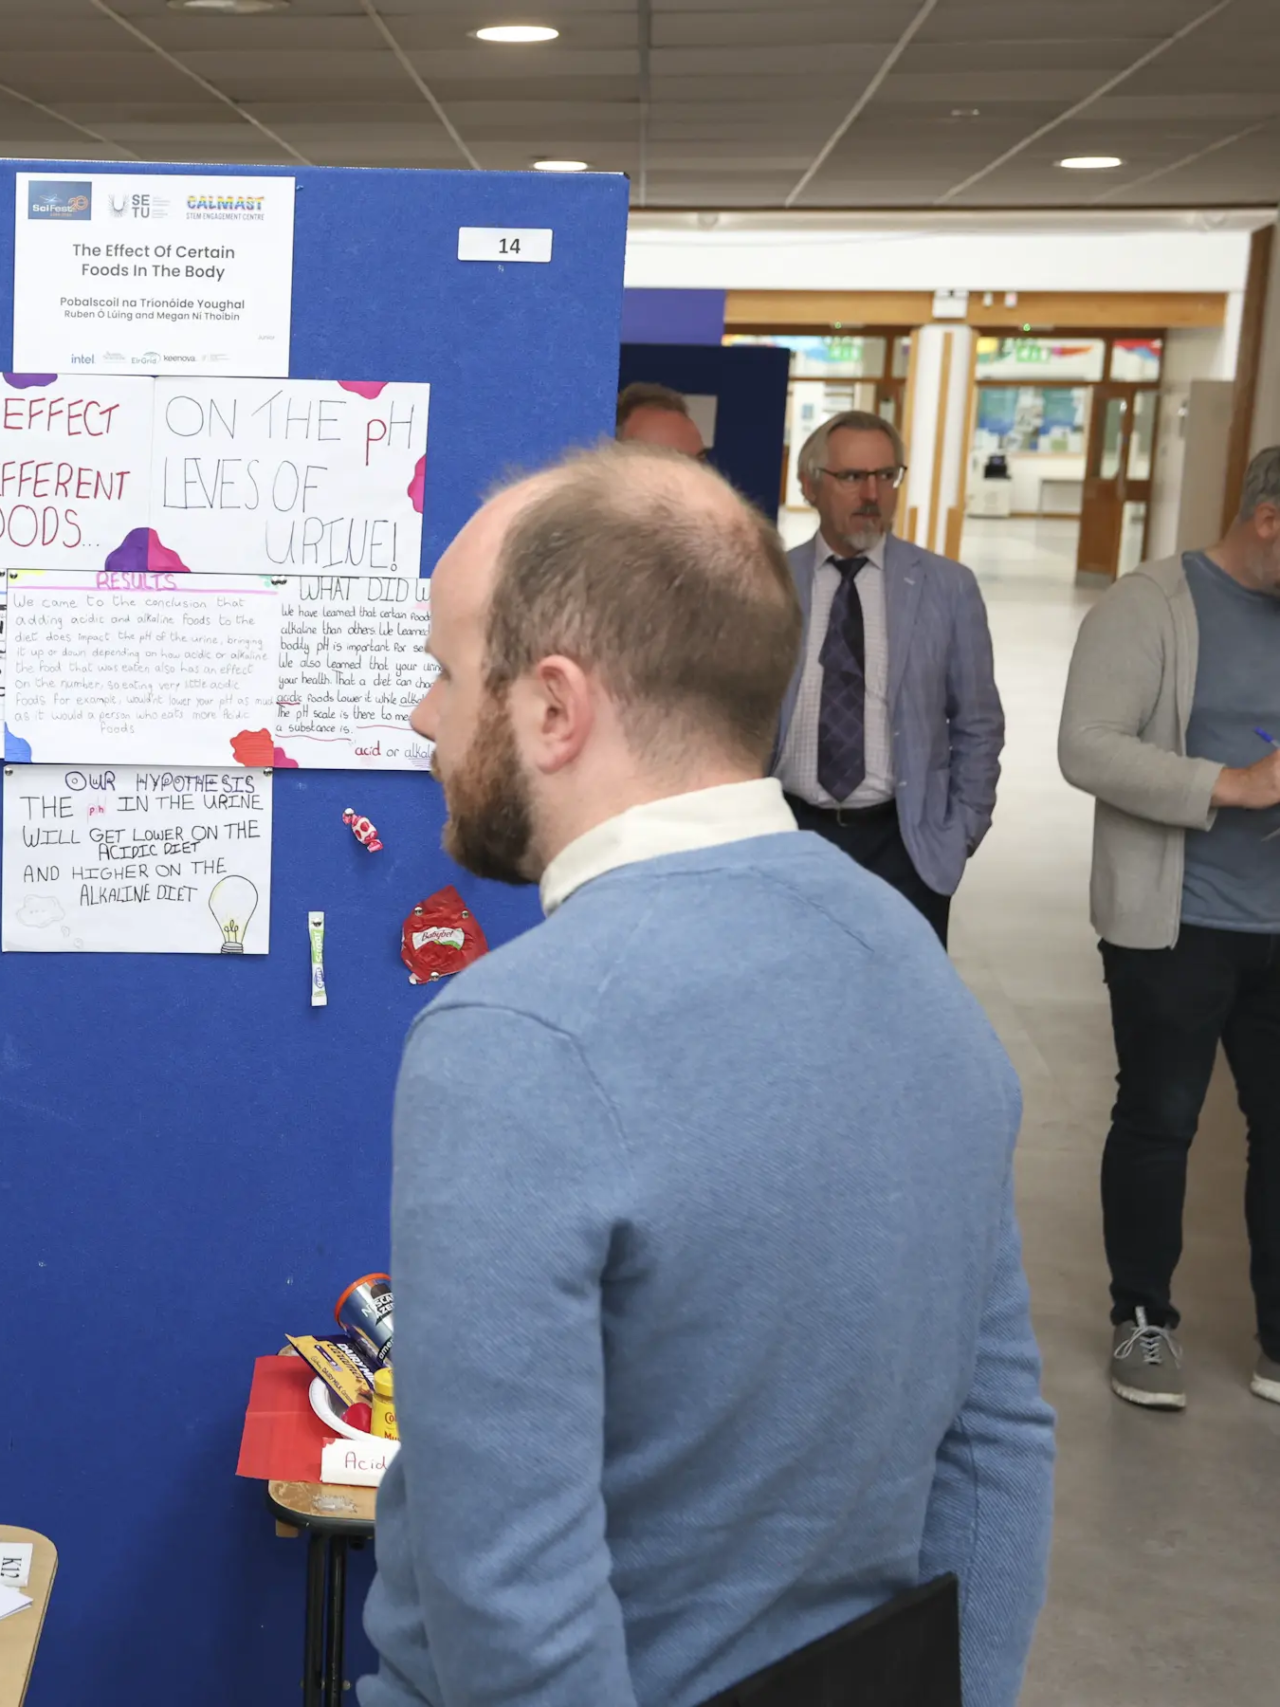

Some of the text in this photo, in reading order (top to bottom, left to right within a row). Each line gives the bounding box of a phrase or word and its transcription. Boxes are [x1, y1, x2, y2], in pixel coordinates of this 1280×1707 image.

[32, 204, 71, 212] SciFest
[132, 194, 150, 206] SE
[186, 195, 265, 211] CALMAST
[133, 206, 150, 218] TU
[186, 212, 264, 221] STEM ENGAGEMENT CENTRE
[72, 244, 235, 258] The Effect Of Certain
[499, 238, 521, 255] 14
[82, 264, 225, 282] Foods In The Body
[60, 297, 120, 308] Pobalscoil
[122, 299, 136, 308] na
[197, 300, 245, 312] Youghal
[64, 310, 94, 318] Ruben
[108, 310, 133, 322] Lúing
[136, 311, 154, 320] and
[157, 312, 190, 322] Megan
[72, 354, 94, 364] intel
[4, 398, 120, 436] EFFECT
[166, 390, 414, 466] ON THE pH
[273, 460, 328, 513] OF
[266, 517, 398, 572] URINE!
[96, 571, 178, 591] RESULTS
[300, 576, 409, 602] WHAT DID
[14, 594, 246, 608] We came to the conclusion that
[282, 603, 406, 620] We have learned that certain
[16, 613, 256, 630] adding acidic and alkaline foods to the
[65, 770, 255, 793] OUR HYPOTHESIS
[20, 796, 74, 820] THE
[117, 795, 148, 812] IN
[156, 794, 195, 810] THE
[204, 794, 264, 810] URINE
[22, 820, 260, 848] WILL GET LOWER ON THE
[98, 841, 200, 860] ACIDIC DIET
[24, 858, 227, 882] AND HIGHER ON THE
[80, 884, 198, 906] ALKALINE DIET
